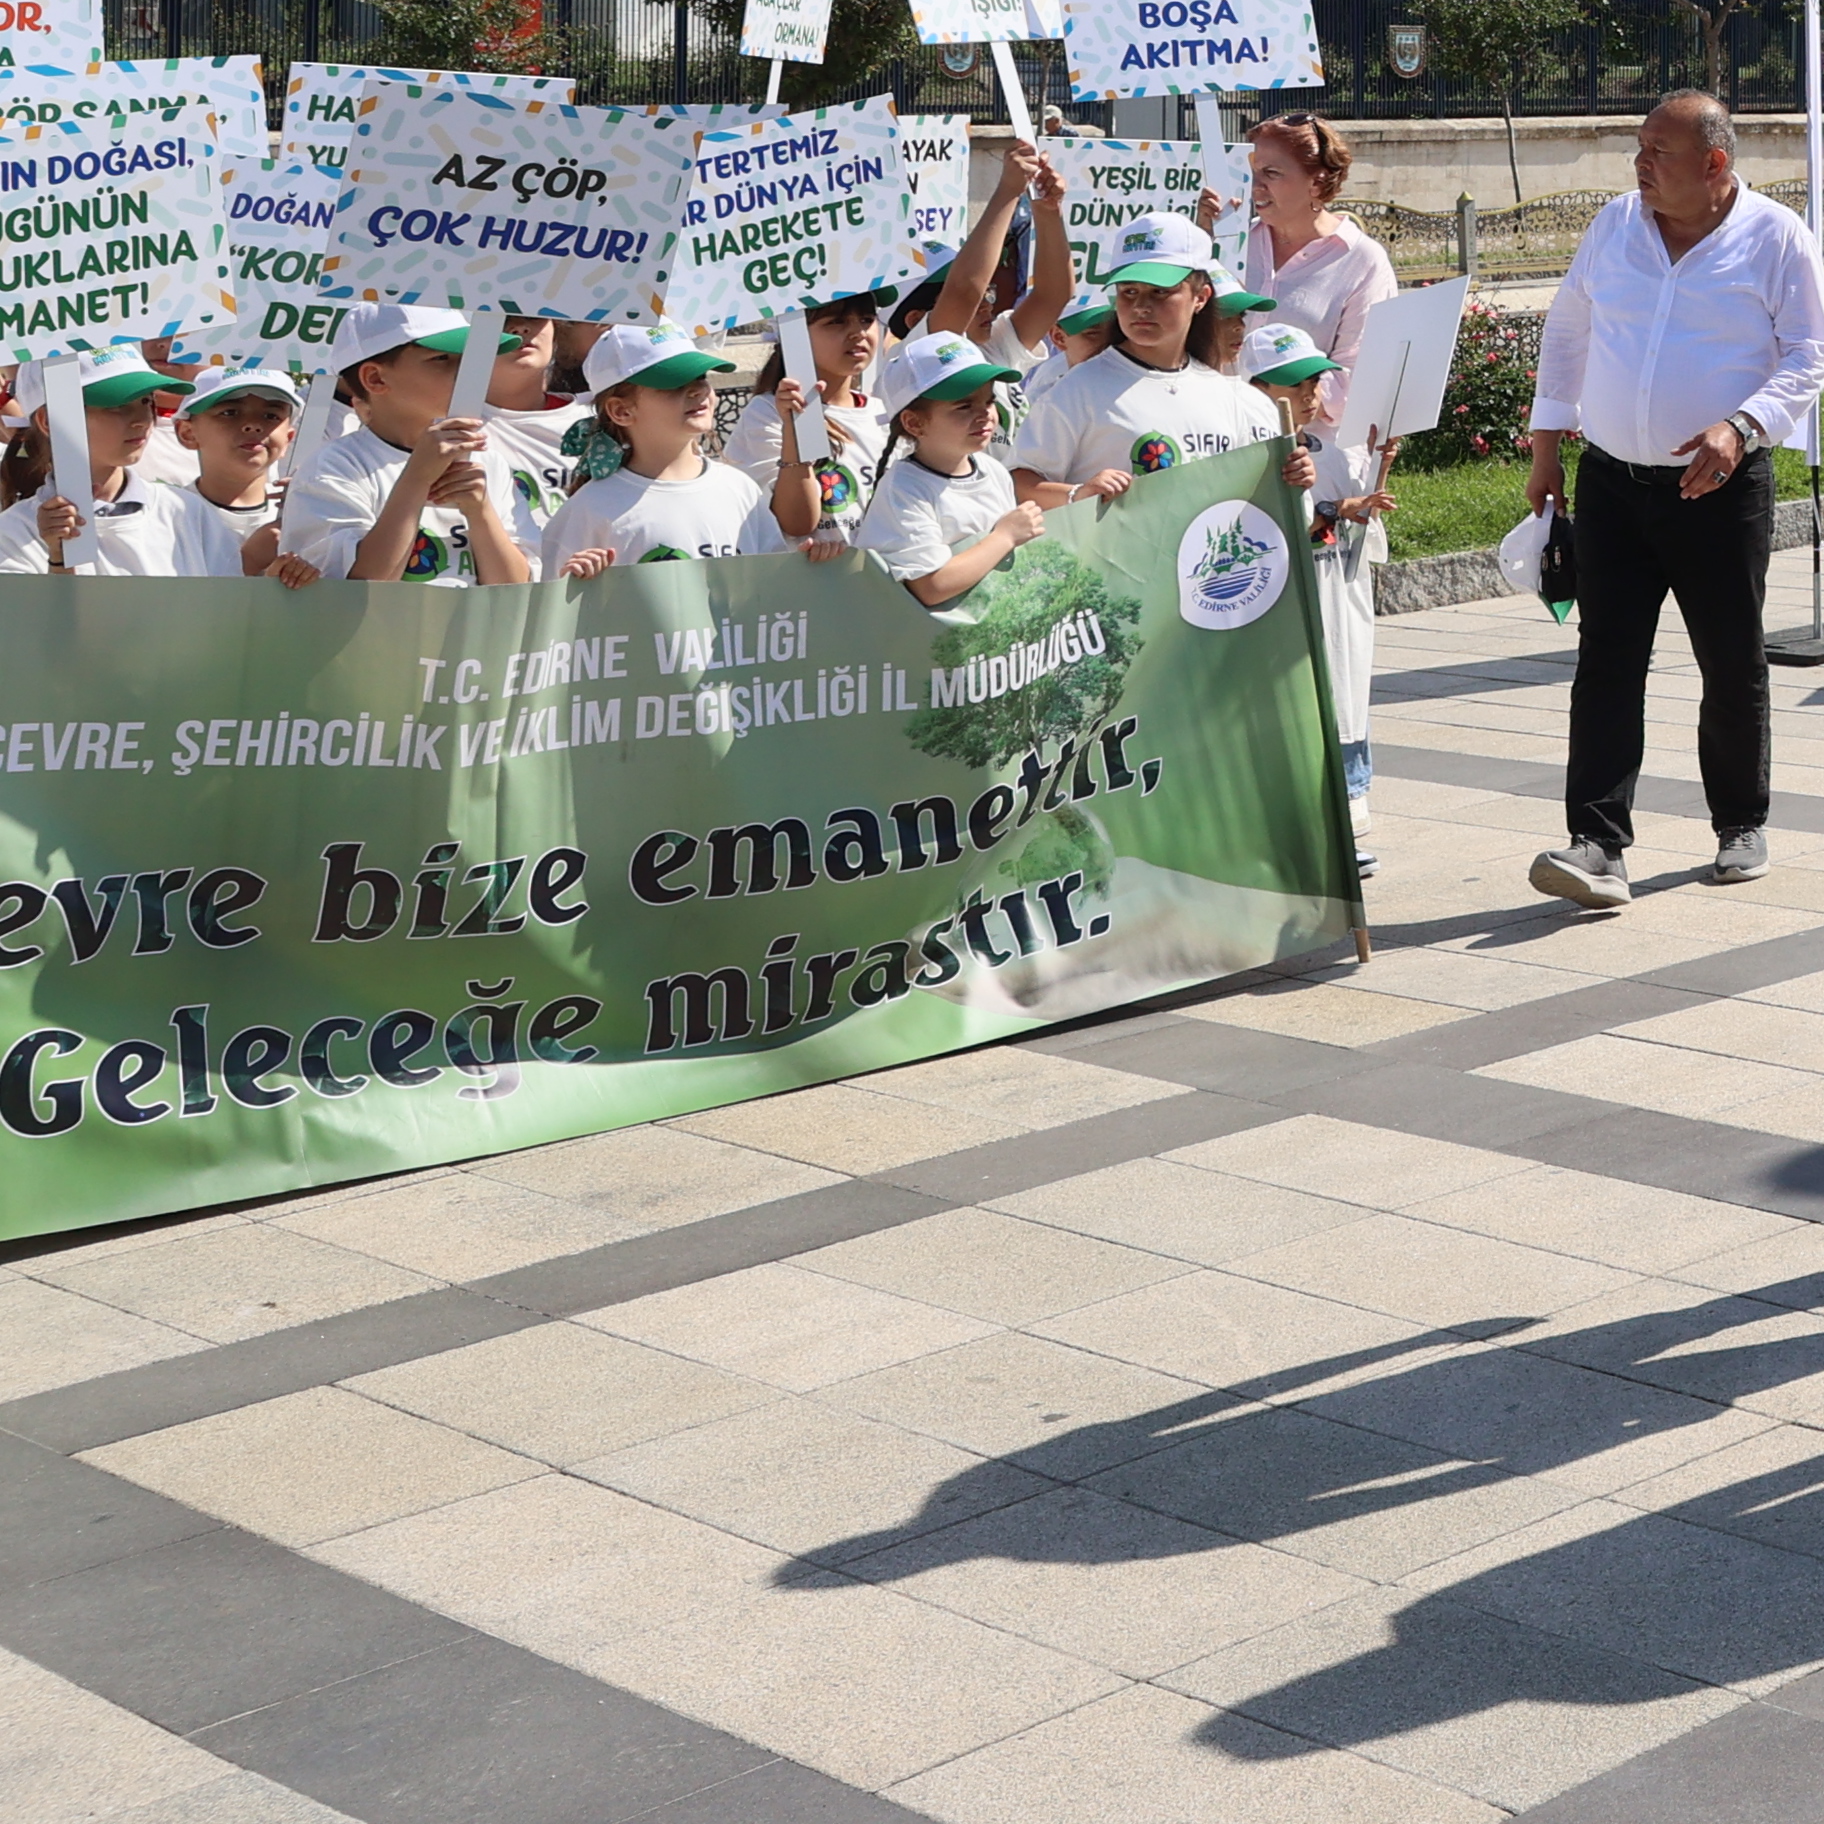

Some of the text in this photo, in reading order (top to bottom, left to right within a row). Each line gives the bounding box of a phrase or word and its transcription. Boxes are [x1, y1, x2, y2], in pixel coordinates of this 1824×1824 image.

[775, 21, 820, 48] ORMANA!
[1138, 0, 1239, 33] BOŞA
[1120, 36, 1269, 71] AKITMA!
[47, 137, 195, 185] DOĞASI,
[431, 153, 607, 207] AZ ÇÖP,
[696, 127, 839, 184] TERTEMİZ
[1089, 161, 1202, 195] YEŞİL BİR
[0, 185, 149, 243] GÜNÜN
[715, 172, 819, 219] DÜNYA
[826, 154, 883, 194] İÇİN
[367, 206, 649, 264] ÇOK HUZUR!
[692, 196, 865, 266] HAREKETE
[742, 242, 827, 294] GEÇ!
[1199, 598, 1239, 613] EDİRNE
[1241, 565, 1273, 606] VALİLİĞİ
[419, 610, 808, 705] T.C. EDİRNE VALİLİĞİ
[171, 711, 447, 776] ŞEHİRCİLİK
[459, 717, 507, 769] VE
[509, 695, 622, 759] İKLİM
[635, 663, 868, 739] DEĞİŞİKLİĞİ
[881, 661, 918, 712] İL
[930, 608, 1107, 711] MÜDÜRLÜĞÜ
[310, 839, 591, 944] bize
[628, 714, 1164, 907] emanettir,
[0, 868, 1113, 1140] Geleceğe mirastır.
